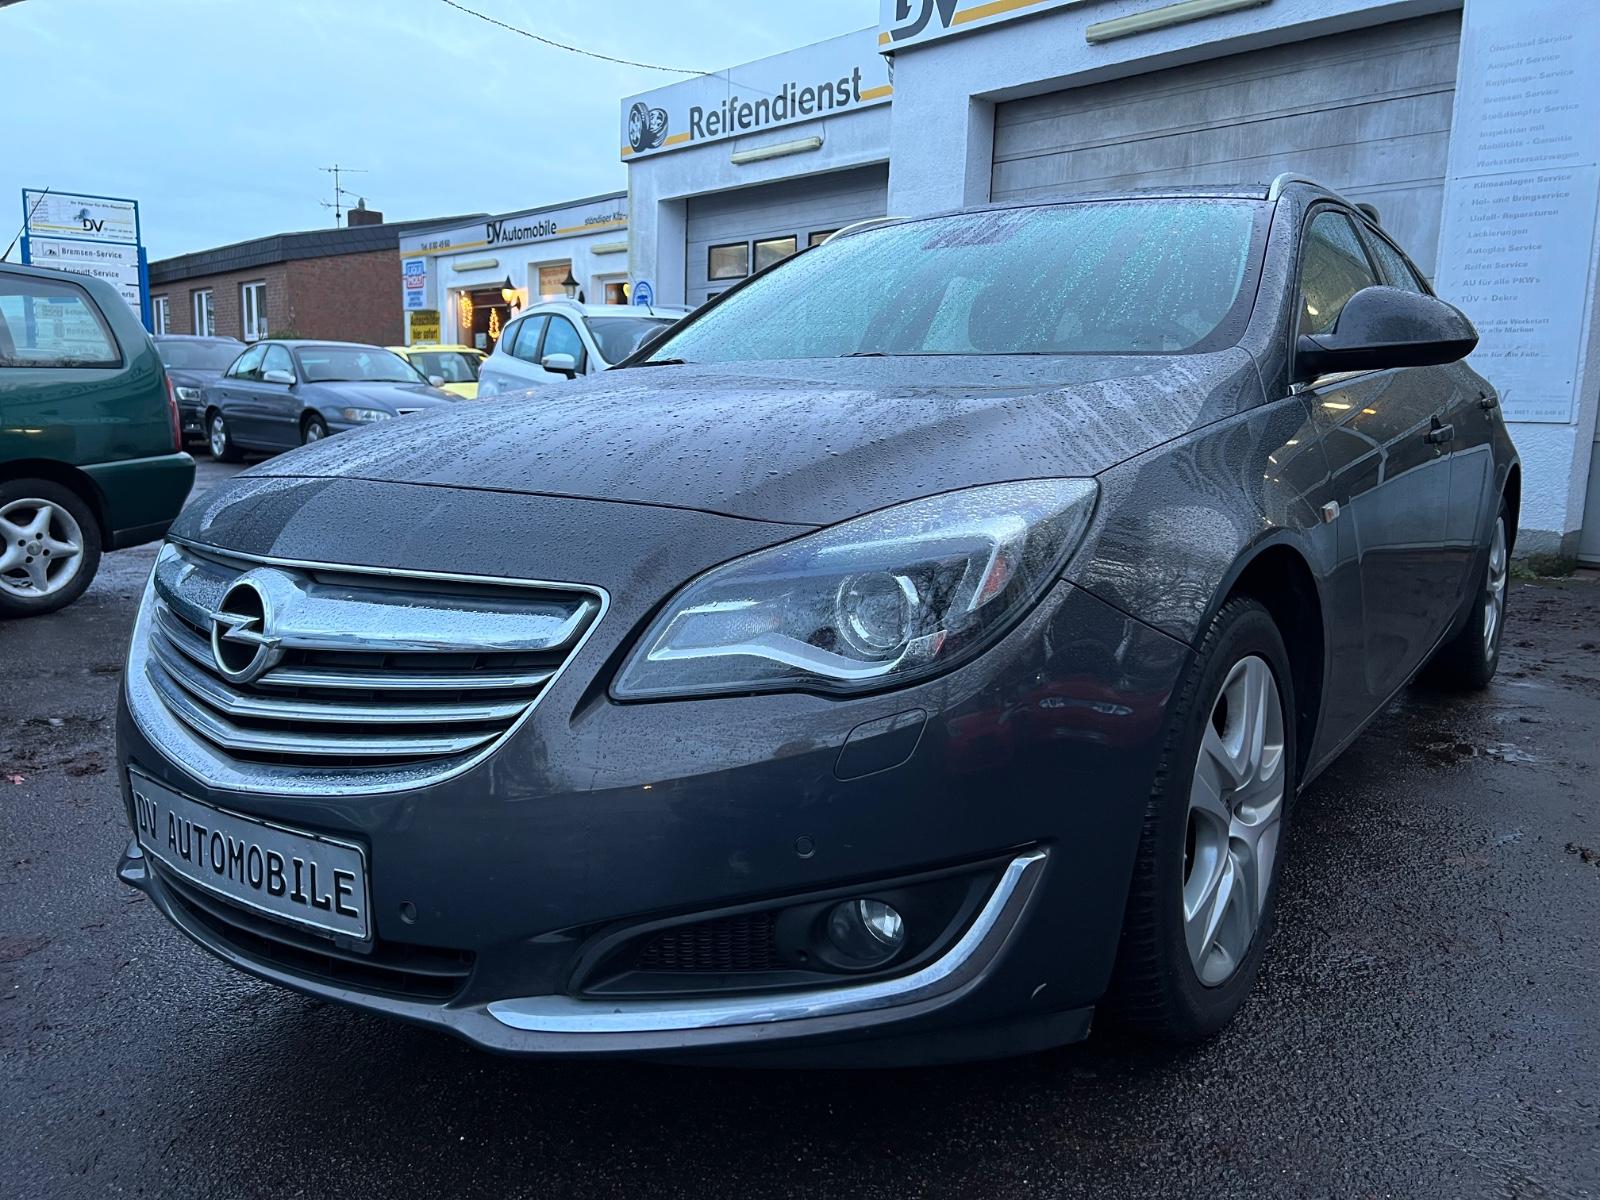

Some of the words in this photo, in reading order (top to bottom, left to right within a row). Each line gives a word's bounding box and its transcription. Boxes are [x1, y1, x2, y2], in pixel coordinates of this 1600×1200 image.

[1537, 34, 1573, 45] Service
[1487, 58, 1523, 70] Auspuff
[1526, 54, 1560, 64] Service
[1539, 70, 1574, 80] Service
[1483, 94, 1522, 104] Bremsen
[1525, 89, 1559, 98] Service
[689, 66, 862, 141] Reifendienst
[1544, 104, 1580, 113] Service
[1480, 128, 1527, 138] Inspektion
[1530, 124, 1545, 132] mit
[1532, 135, 1573, 145] Garantie
[1474, 178, 1534, 189] Klimaanlagen
[1537, 174, 1573, 183] Service
[1471, 198, 1490, 206] Hol-
[1512, 192, 1570, 202] Bringservice
[1470, 213, 1500, 222] Unfall-
[1502, 209, 1559, 220] Reparaturen
[82, 218, 104, 232] DV
[486, 220, 503, 244] DV
[502, 219, 557, 242] Automobile
[1467, 229, 1528, 239] Lackierungen
[61, 247, 122, 259] Bremsen-Service
[1466, 246, 1505, 255] Autoglas
[1508, 243, 1542, 252] Service
[1464, 262, 1492, 271] Reifen
[1495, 261, 1528, 269] Service
[1462, 279, 1476, 287] AU
[1478, 278, 1491, 286] für
[1461, 294, 1480, 303] TÜV
[1491, 294, 1518, 302] Dekra
[134, 791, 157, 840] DV
[168, 810, 360, 918] AUTOMOBILE
